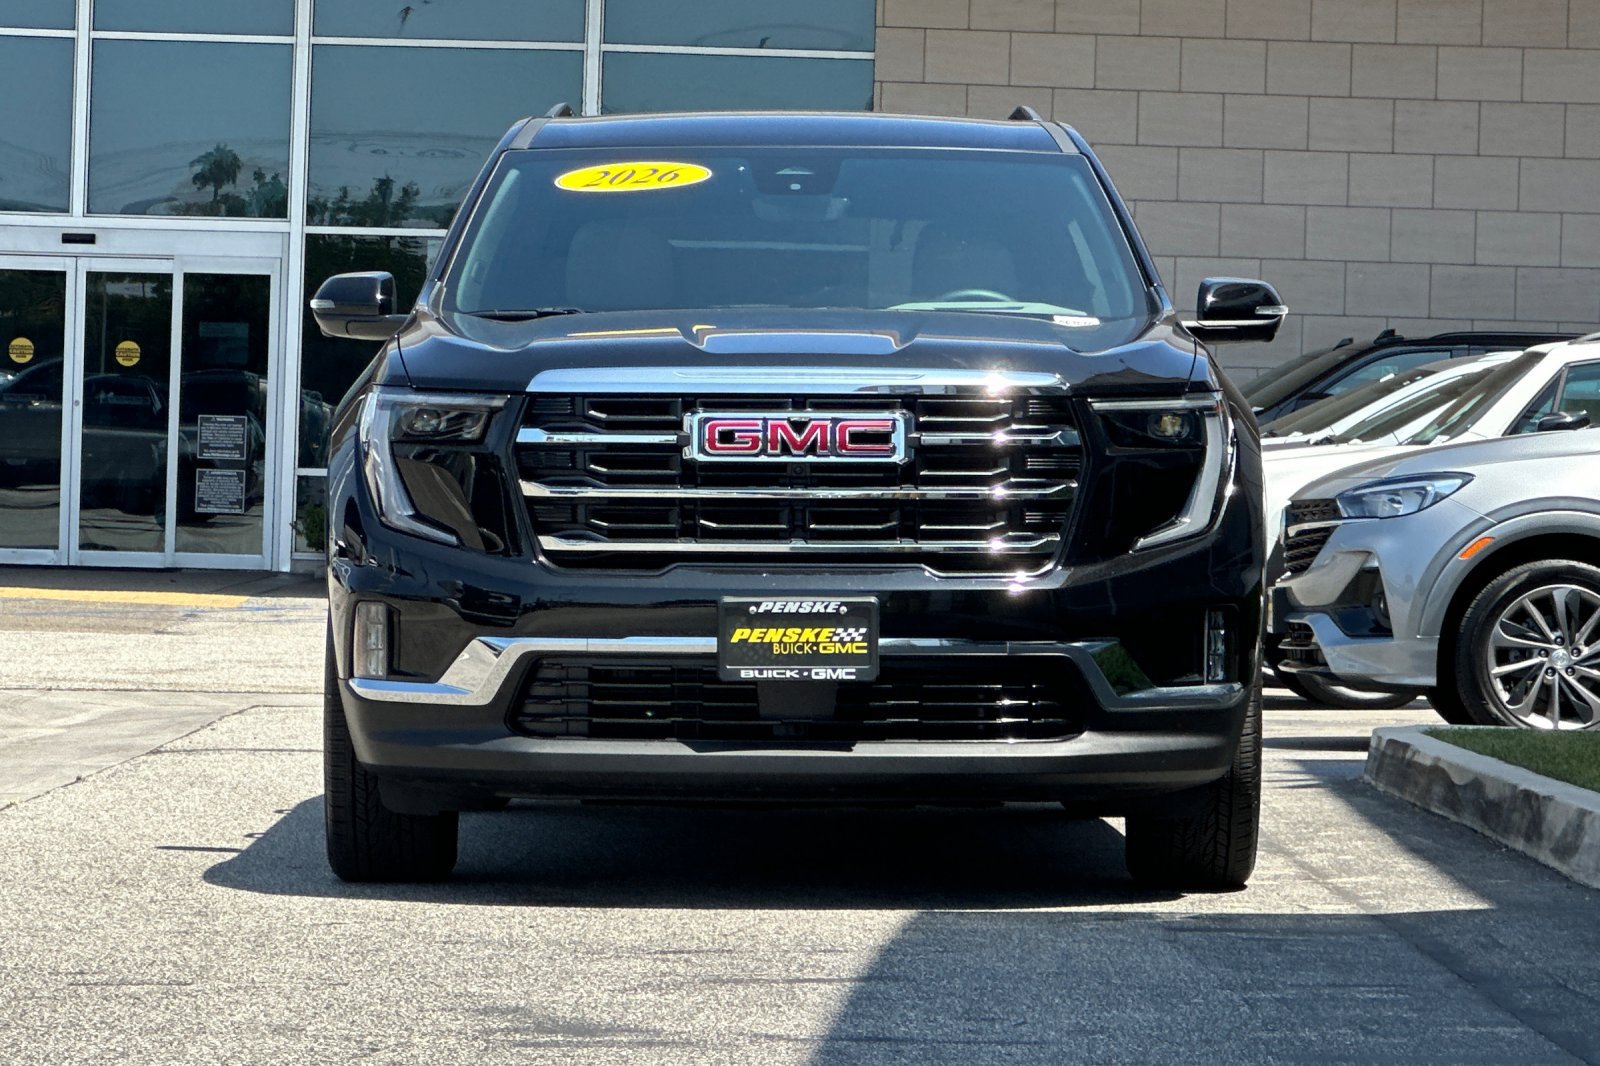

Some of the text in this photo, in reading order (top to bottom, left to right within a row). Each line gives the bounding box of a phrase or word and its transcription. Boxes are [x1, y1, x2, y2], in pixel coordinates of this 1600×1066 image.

[580, 168, 684, 187] 2026
[705, 419, 897, 455] GMC
[758, 602, 841, 613] PENSKE
[731, 628, 836, 642] PENSKE
[819, 643, 868, 654] GMC
[811, 669, 856, 679] GMC
